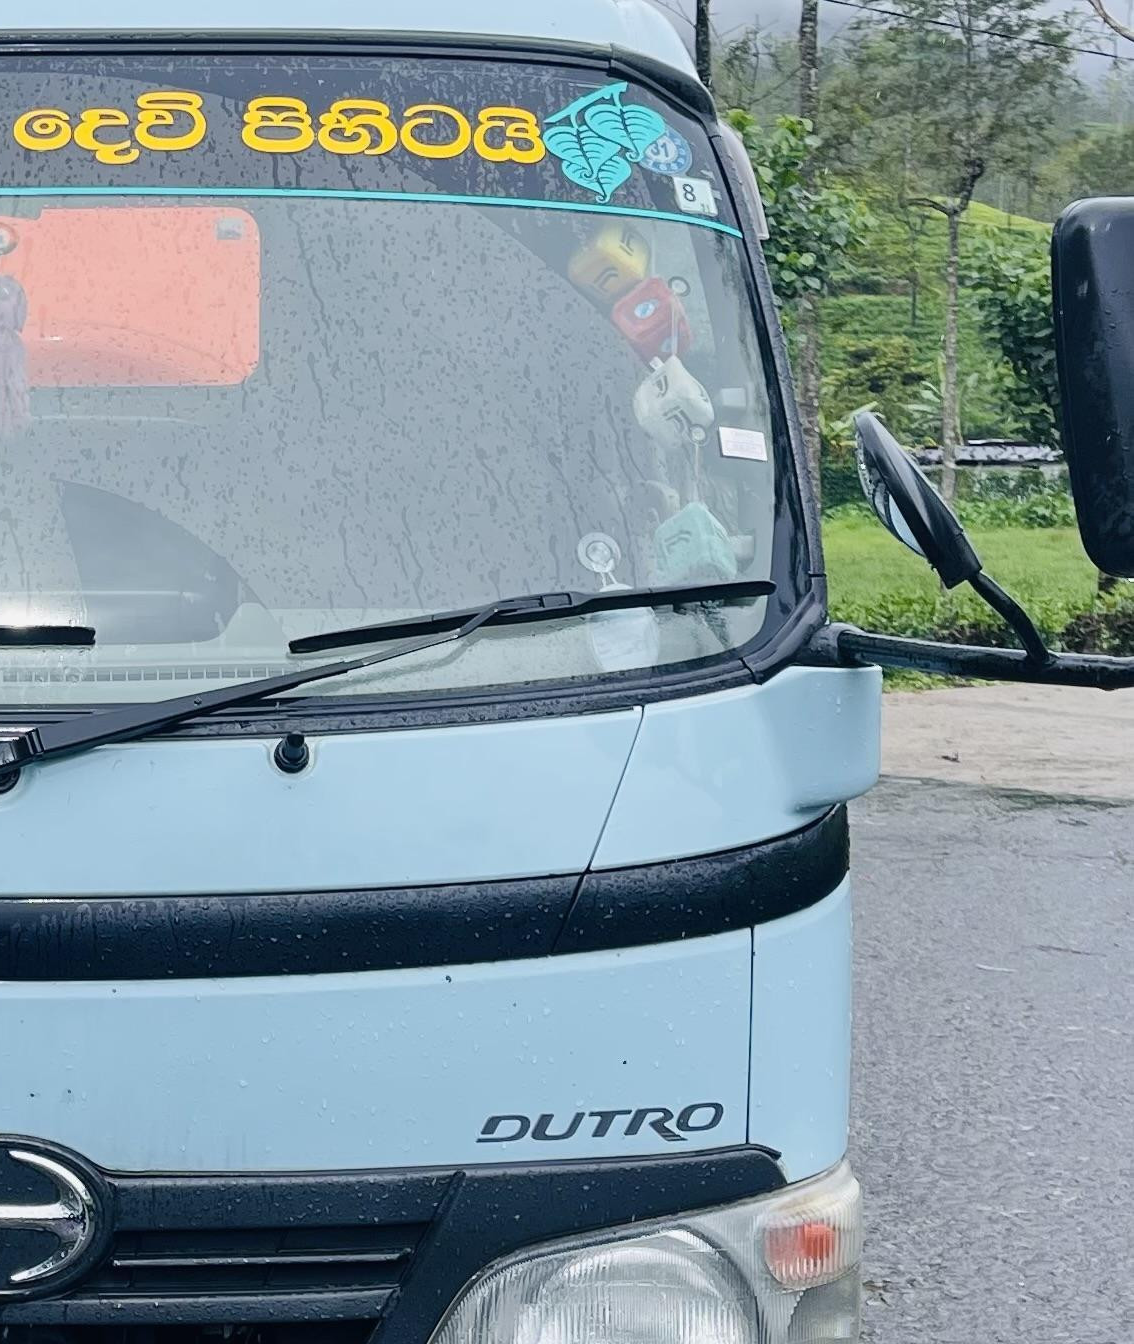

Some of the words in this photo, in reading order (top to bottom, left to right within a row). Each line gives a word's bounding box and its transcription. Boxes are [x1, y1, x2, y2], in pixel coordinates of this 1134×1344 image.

[241, 96, 547, 164] පිහිටයි
[682, 183, 697, 202] 8
[476, 1102, 724, 1143] DUTRO
